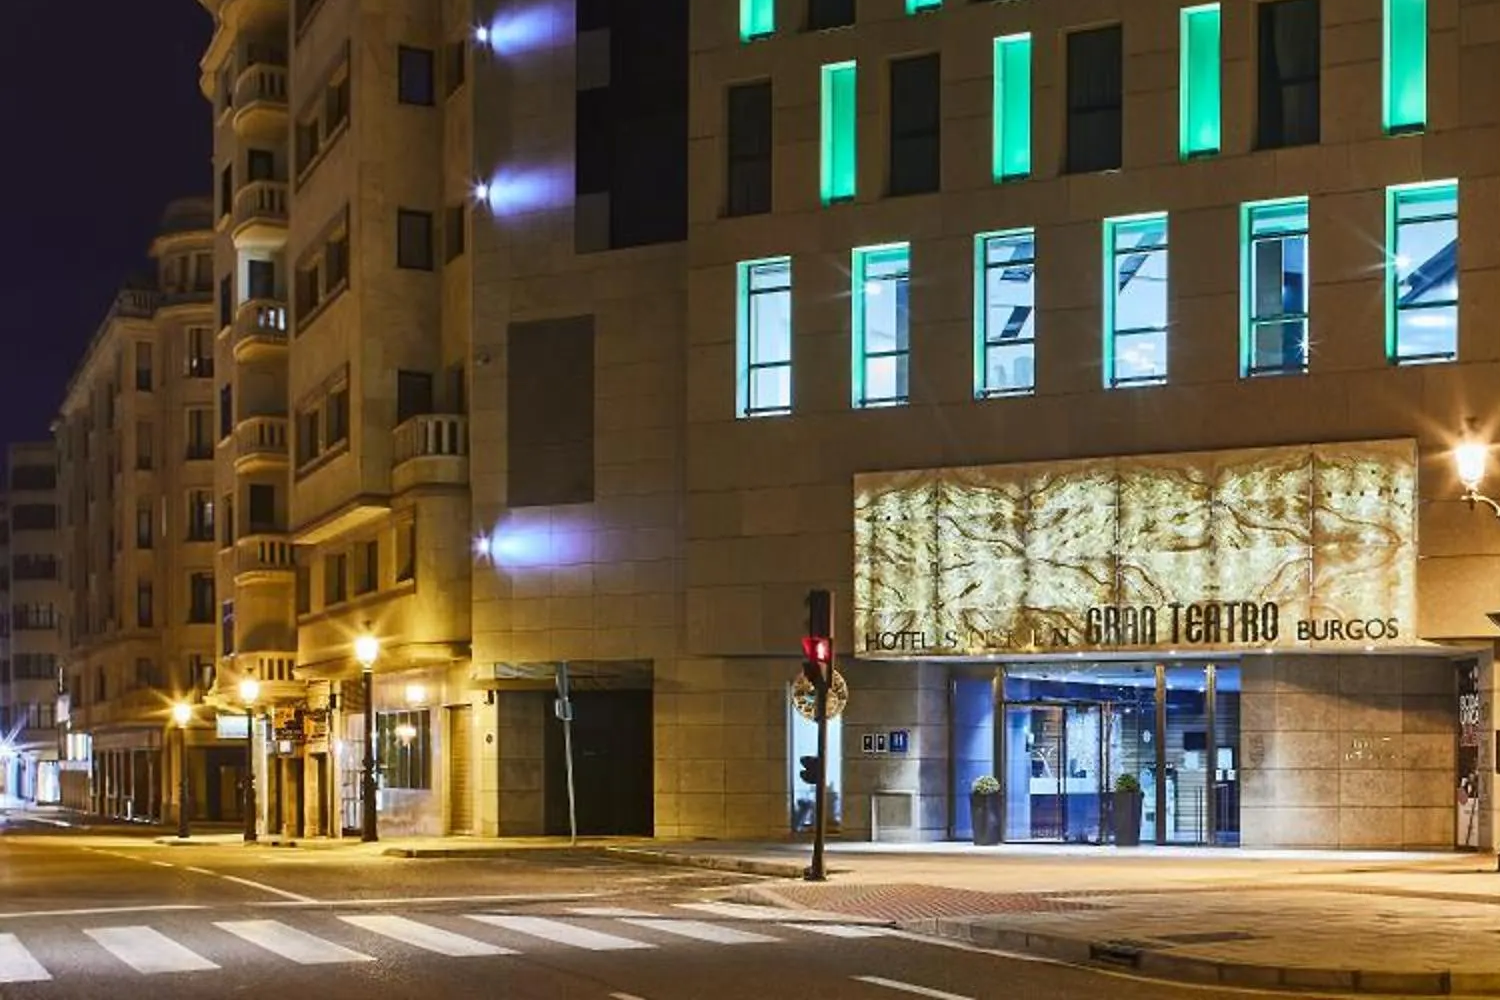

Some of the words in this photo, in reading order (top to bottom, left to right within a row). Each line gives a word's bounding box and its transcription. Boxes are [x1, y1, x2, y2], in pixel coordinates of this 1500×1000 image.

[865, 630, 926, 651] HOTEL
[1083, 604, 1157, 645] GRAN
[1167, 600, 1279, 644] TEATRO
[1297, 617, 1399, 641] BURGOS
